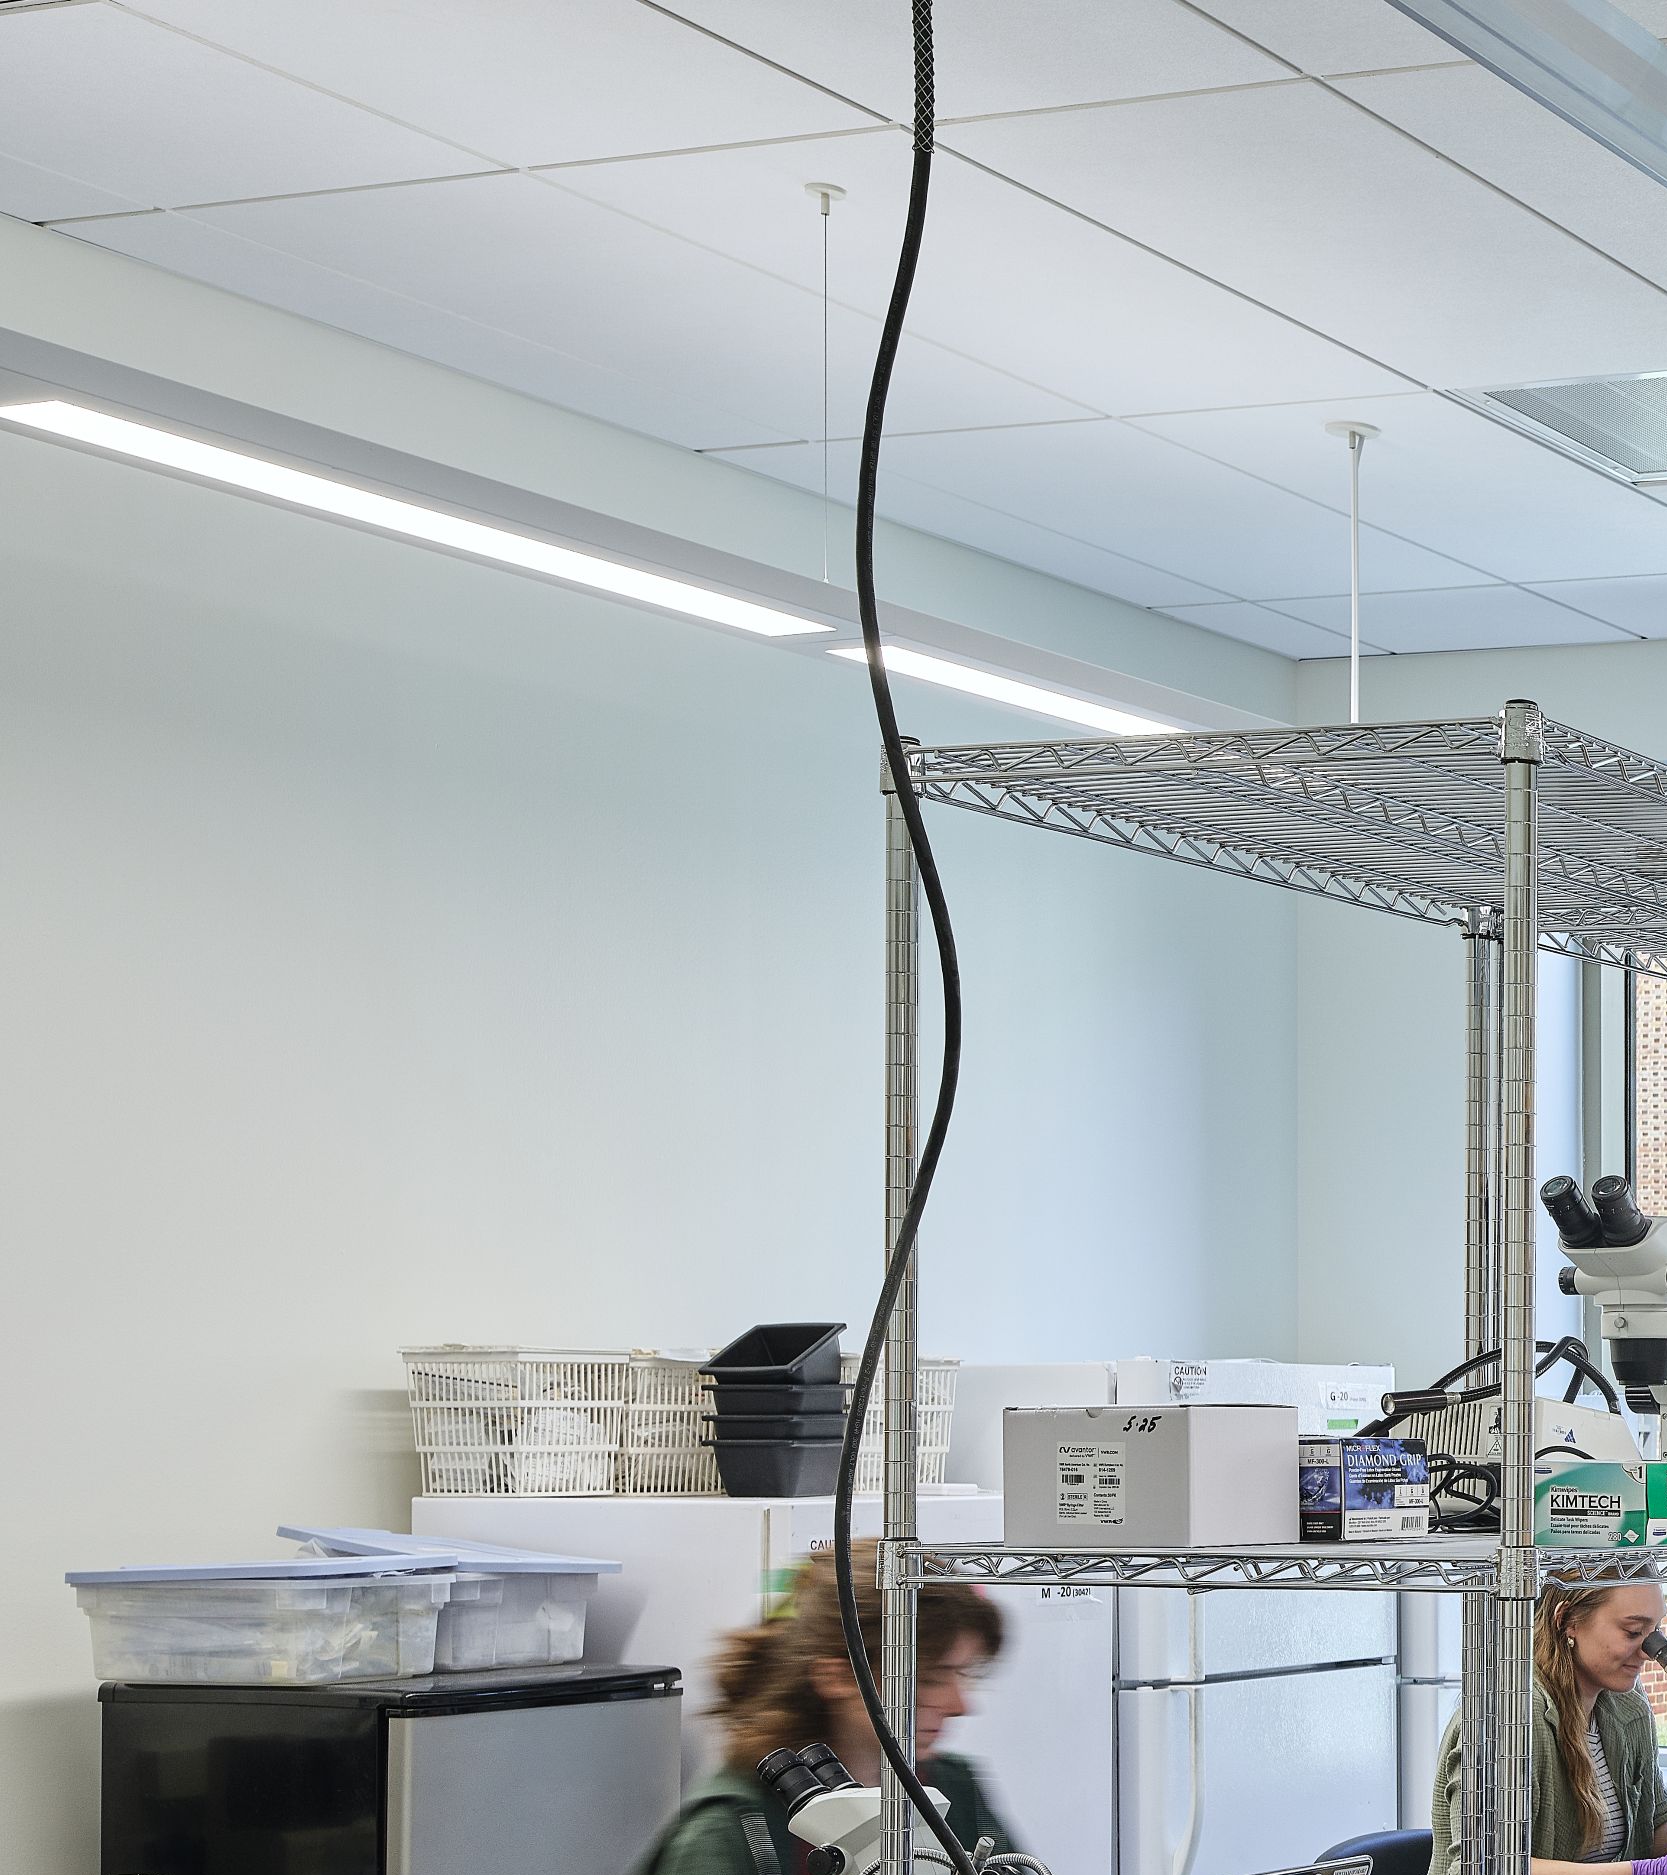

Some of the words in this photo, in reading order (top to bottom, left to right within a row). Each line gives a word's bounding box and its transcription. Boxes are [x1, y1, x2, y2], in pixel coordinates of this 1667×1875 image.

[1174, 1366, 1207, 1376] CAUTION
[1347, 1454, 1396, 1466] DIAMOND
[1638, 1466, 1643, 1479] 1
[1551, 1495, 1621, 1509] KIMTECH
[1042, 1588, 1051, 1599] M
[1057, 1586, 1072, 1598] -20
